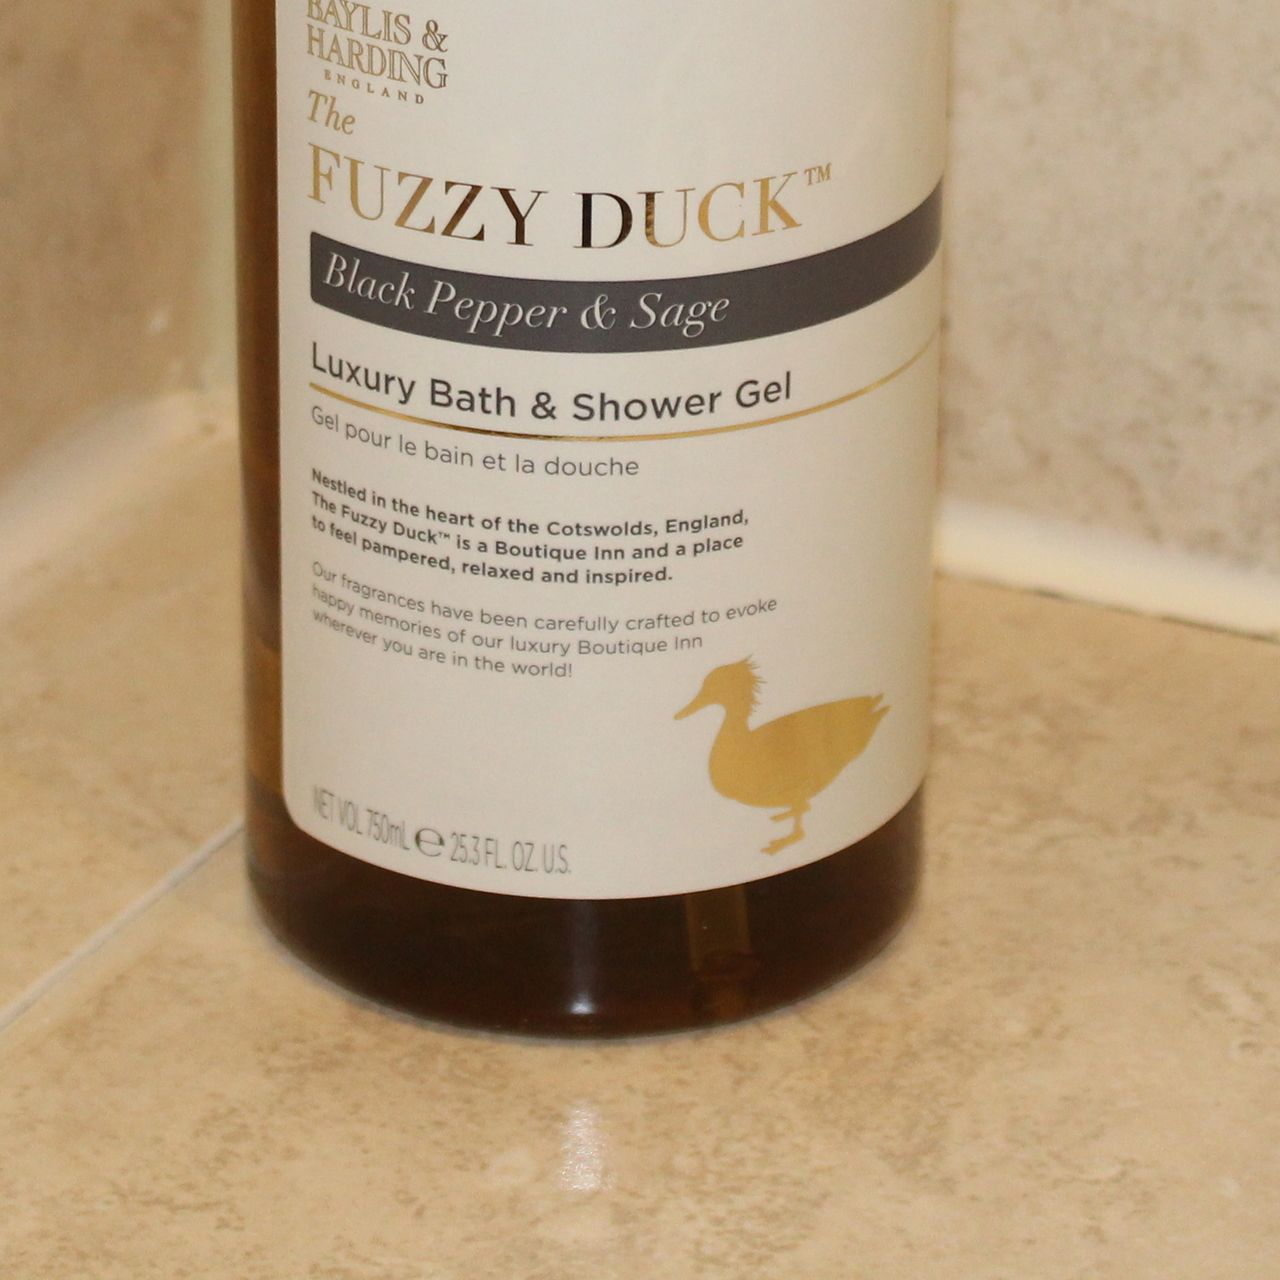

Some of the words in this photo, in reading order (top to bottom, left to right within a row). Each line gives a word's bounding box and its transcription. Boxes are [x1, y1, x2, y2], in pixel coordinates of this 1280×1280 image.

[306, 23, 448, 89] HARDING
[421, 19, 448, 53] &
[307, 89, 356, 135] The
[323, 69, 425, 105] ENGLAND
[307, 142, 549, 247] FUZZY
[322, 251, 416, 311] Black
[423, 280, 568, 338] Pepper
[580, 294, 617, 330] &
[629, 292, 730, 338] Sage
[312, 341, 416, 405] Luxury
[430, 378, 516, 418] Bath
[531, 391, 557, 420] &
[572, 391, 722, 421] Shower
[736, 371, 792, 408] Gel
[311, 405, 339, 432] Gel
[345, 422, 391, 450] pour
[399, 434, 417, 456] le
[425, 441, 473, 467] bain
[482, 452, 506, 471] et
[516, 454, 535, 475] la
[544, 457, 640, 477] douche
[311, 467, 367, 503] Nestled
[372, 491, 386, 509] in
[392, 497, 420, 517] the
[426, 505, 475, 528] heart
[481, 517, 502, 531] of
[507, 518, 540, 535] the
[547, 521, 659, 537] Cotswolds,
[665, 509, 749, 535] England,
[311, 490, 337, 514] The
[341, 504, 388, 534] Fuzzy
[457, 533, 471, 551] is
[477, 541, 489, 554] a
[495, 540, 587, 562] Boutique
[595, 545, 625, 561] Inn
[632, 542, 669, 560] and
[675, 543, 687, 557] a
[693, 534, 744, 558] place
[311, 515, 326, 533] to
[330, 522, 357, 546] feel
[361, 537, 456, 575] pampered,
[462, 561, 535, 582] relaxed
[541, 568, 579, 584] and
[585, 566, 674, 587] inspired.
[311, 560, 337, 584] Our
[341, 573, 426, 613] fragrances
[431, 599, 473, 622] have
[480, 607, 528, 629] been
[534, 615, 619, 635] carefully
[625, 610, 695, 632] crafted
[701, 608, 721, 625] to
[726, 596, 778, 621] evoke
[312, 583, 355, 617] happy
[359, 605, 441, 640] memories
[447, 628, 466, 644] of
[472, 633, 504, 650] our
[510, 635, 571, 658] luxury
[578, 639, 669, 657] Boutique
[674, 634, 703, 651] Inn
[312, 608, 378, 646] wherever
[383, 636, 413, 657] you
[418, 645, 447, 665] are
[452, 650, 469, 668] in
[475, 655, 505, 674] the
[511, 662, 573, 679] world!
[312, 784, 335, 823] NET
[366, 807, 411, 852] 750mL
[449, 830, 481, 867] 25.3
[484, 836, 507, 871] FL.
[542, 842, 573, 875] U.S.
